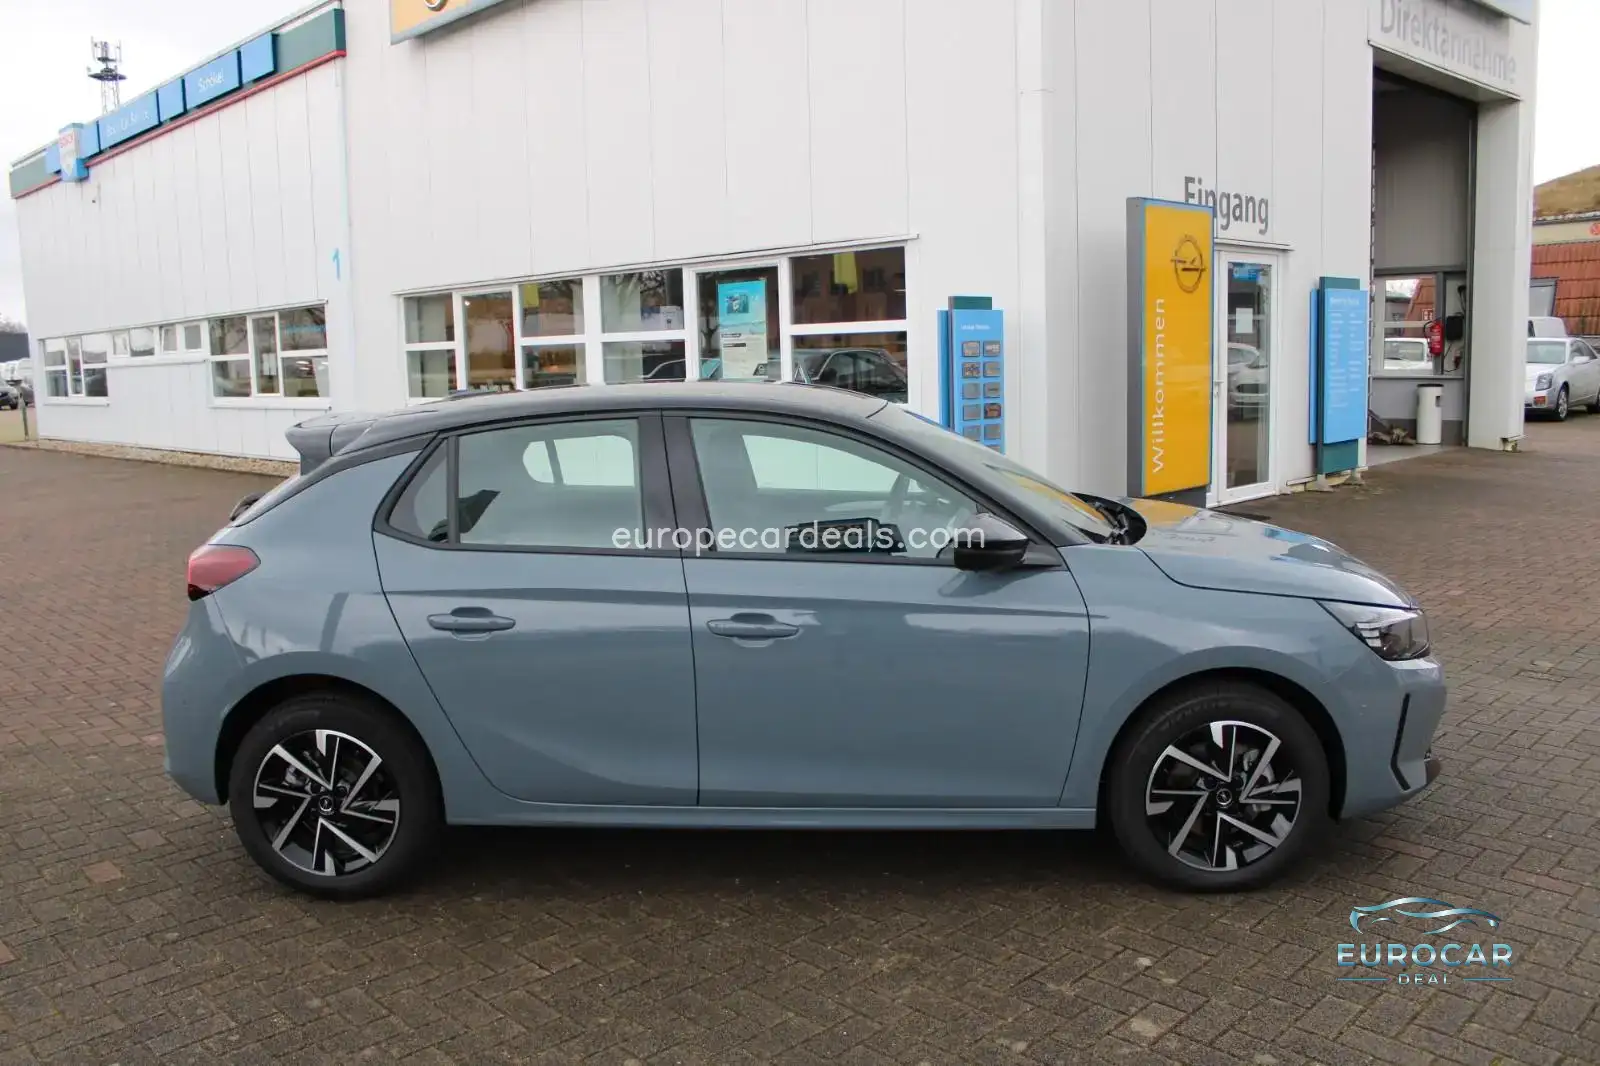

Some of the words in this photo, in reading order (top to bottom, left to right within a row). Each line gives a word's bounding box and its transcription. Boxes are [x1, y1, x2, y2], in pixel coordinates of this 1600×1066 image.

[1380, 0, 1517, 84] Direktannahme
[1184, 176, 1269, 235] Eingang
[1151, 298, 1166, 473] Willkommen
